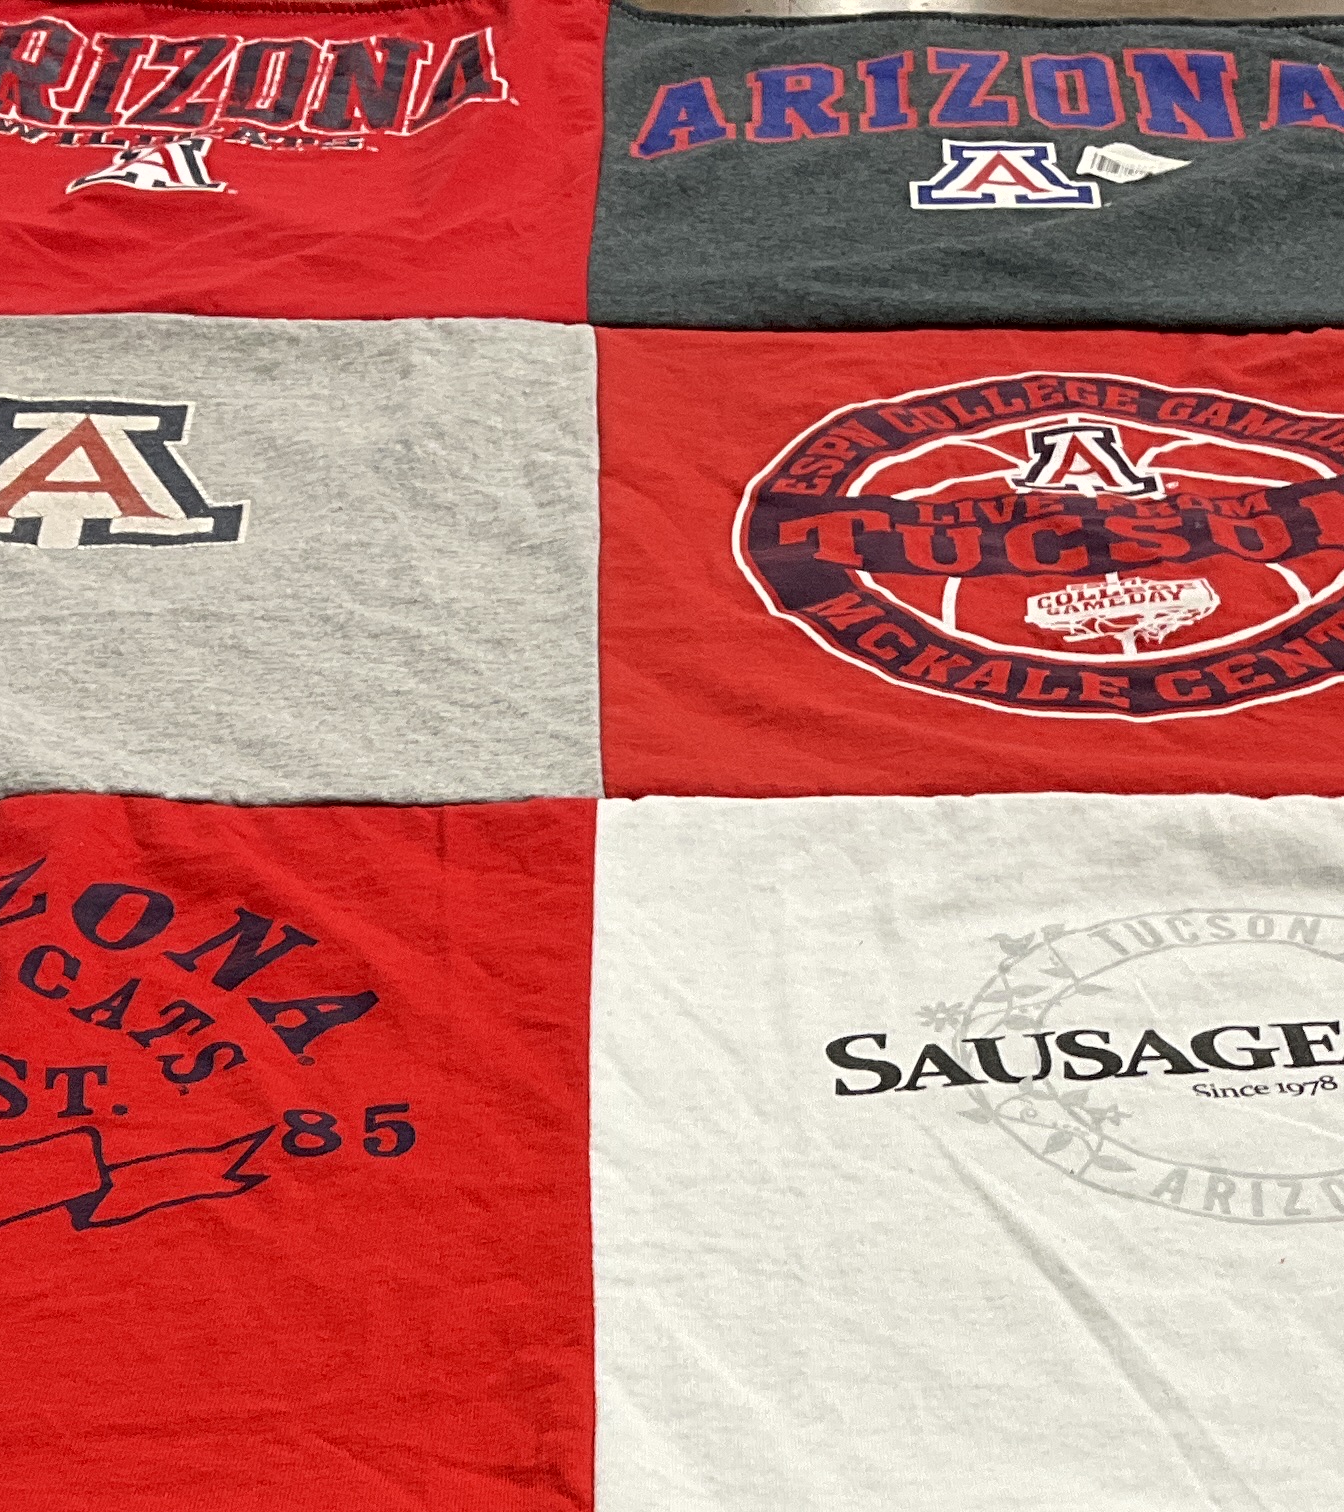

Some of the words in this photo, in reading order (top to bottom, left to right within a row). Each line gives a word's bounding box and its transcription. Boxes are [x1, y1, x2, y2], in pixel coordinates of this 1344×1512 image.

[910, 138, 1102, 210] A
[771, 418, 888, 496] ESPN
[878, 379, 1141, 433] COLLEGE
[1005, 420, 1166, 499] A
[915, 496, 1066, 525] LIVE
[800, 592, 1132, 709] MCKALE
[1089, 912, 1322, 959] TUCSON
[1192, 1083, 1271, 1099] Since
[1276, 1074, 1339, 1097] 1978
[280, 1102, 417, 1158] 85
